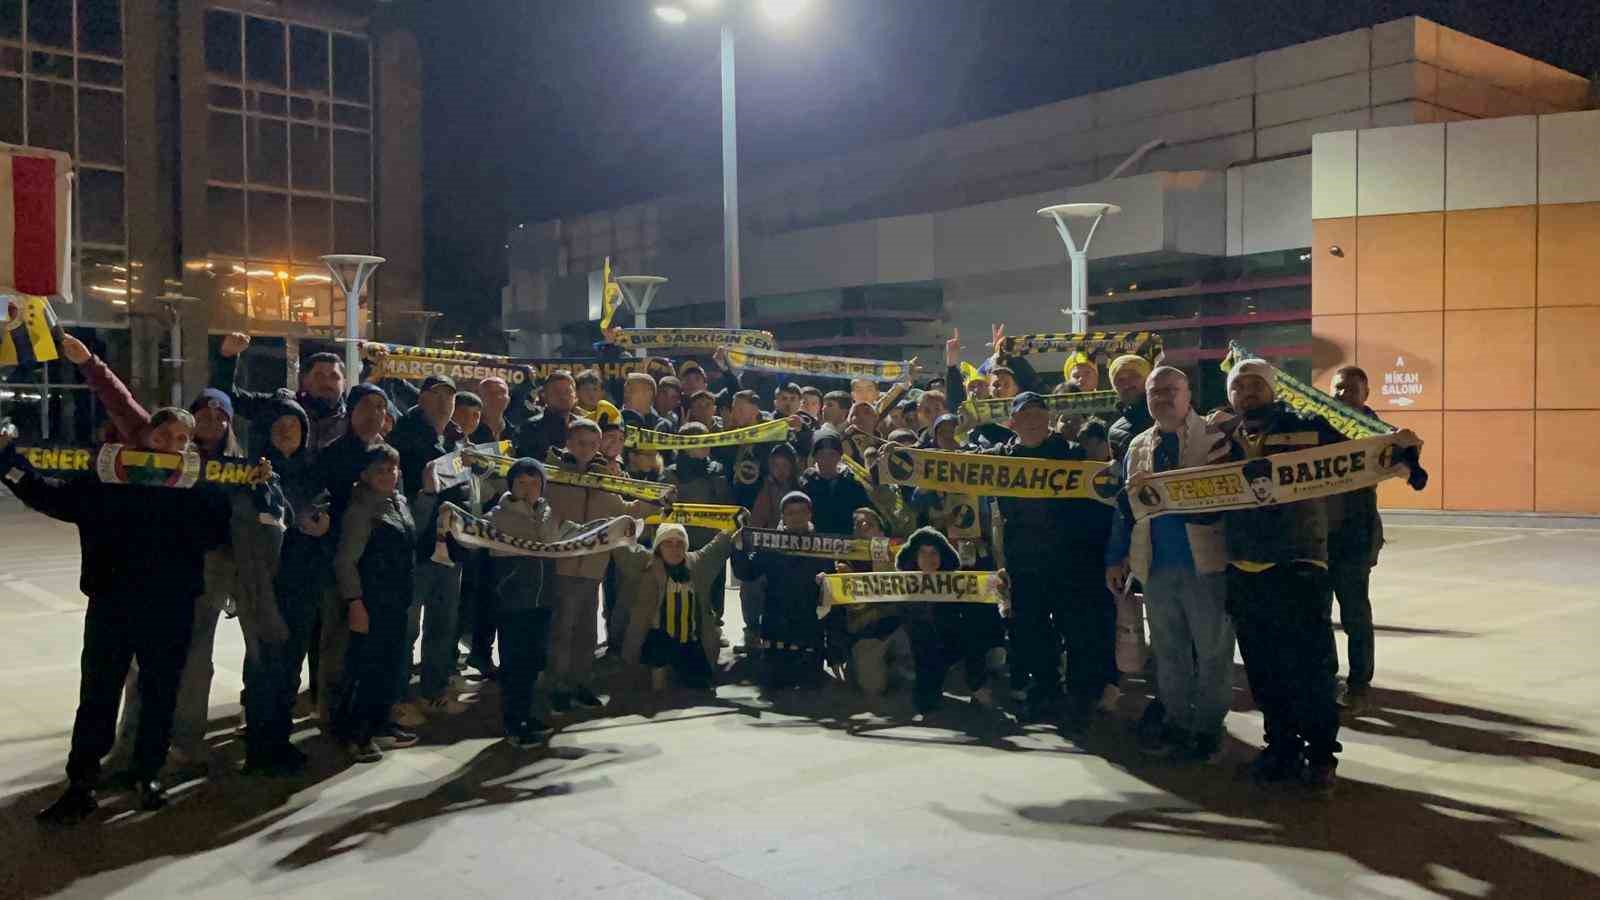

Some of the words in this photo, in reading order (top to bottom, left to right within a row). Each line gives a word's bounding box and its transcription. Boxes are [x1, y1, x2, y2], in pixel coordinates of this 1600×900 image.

[383, 358, 445, 375] MARCO
[449, 362, 525, 385] ASENSIO
[1395, 355, 1405, 368] A
[1381, 383, 1423, 396] SALONU
[206, 460, 254, 485] BAH
[922, 459, 1084, 495] FENERBAHÇE
[1165, 473, 1242, 501] FENER
[1277, 450, 1366, 485] BAHÇE
[752, 531, 850, 557] FENERBAHÇE
[842, 573, 978, 598] FENERBAHÇE
